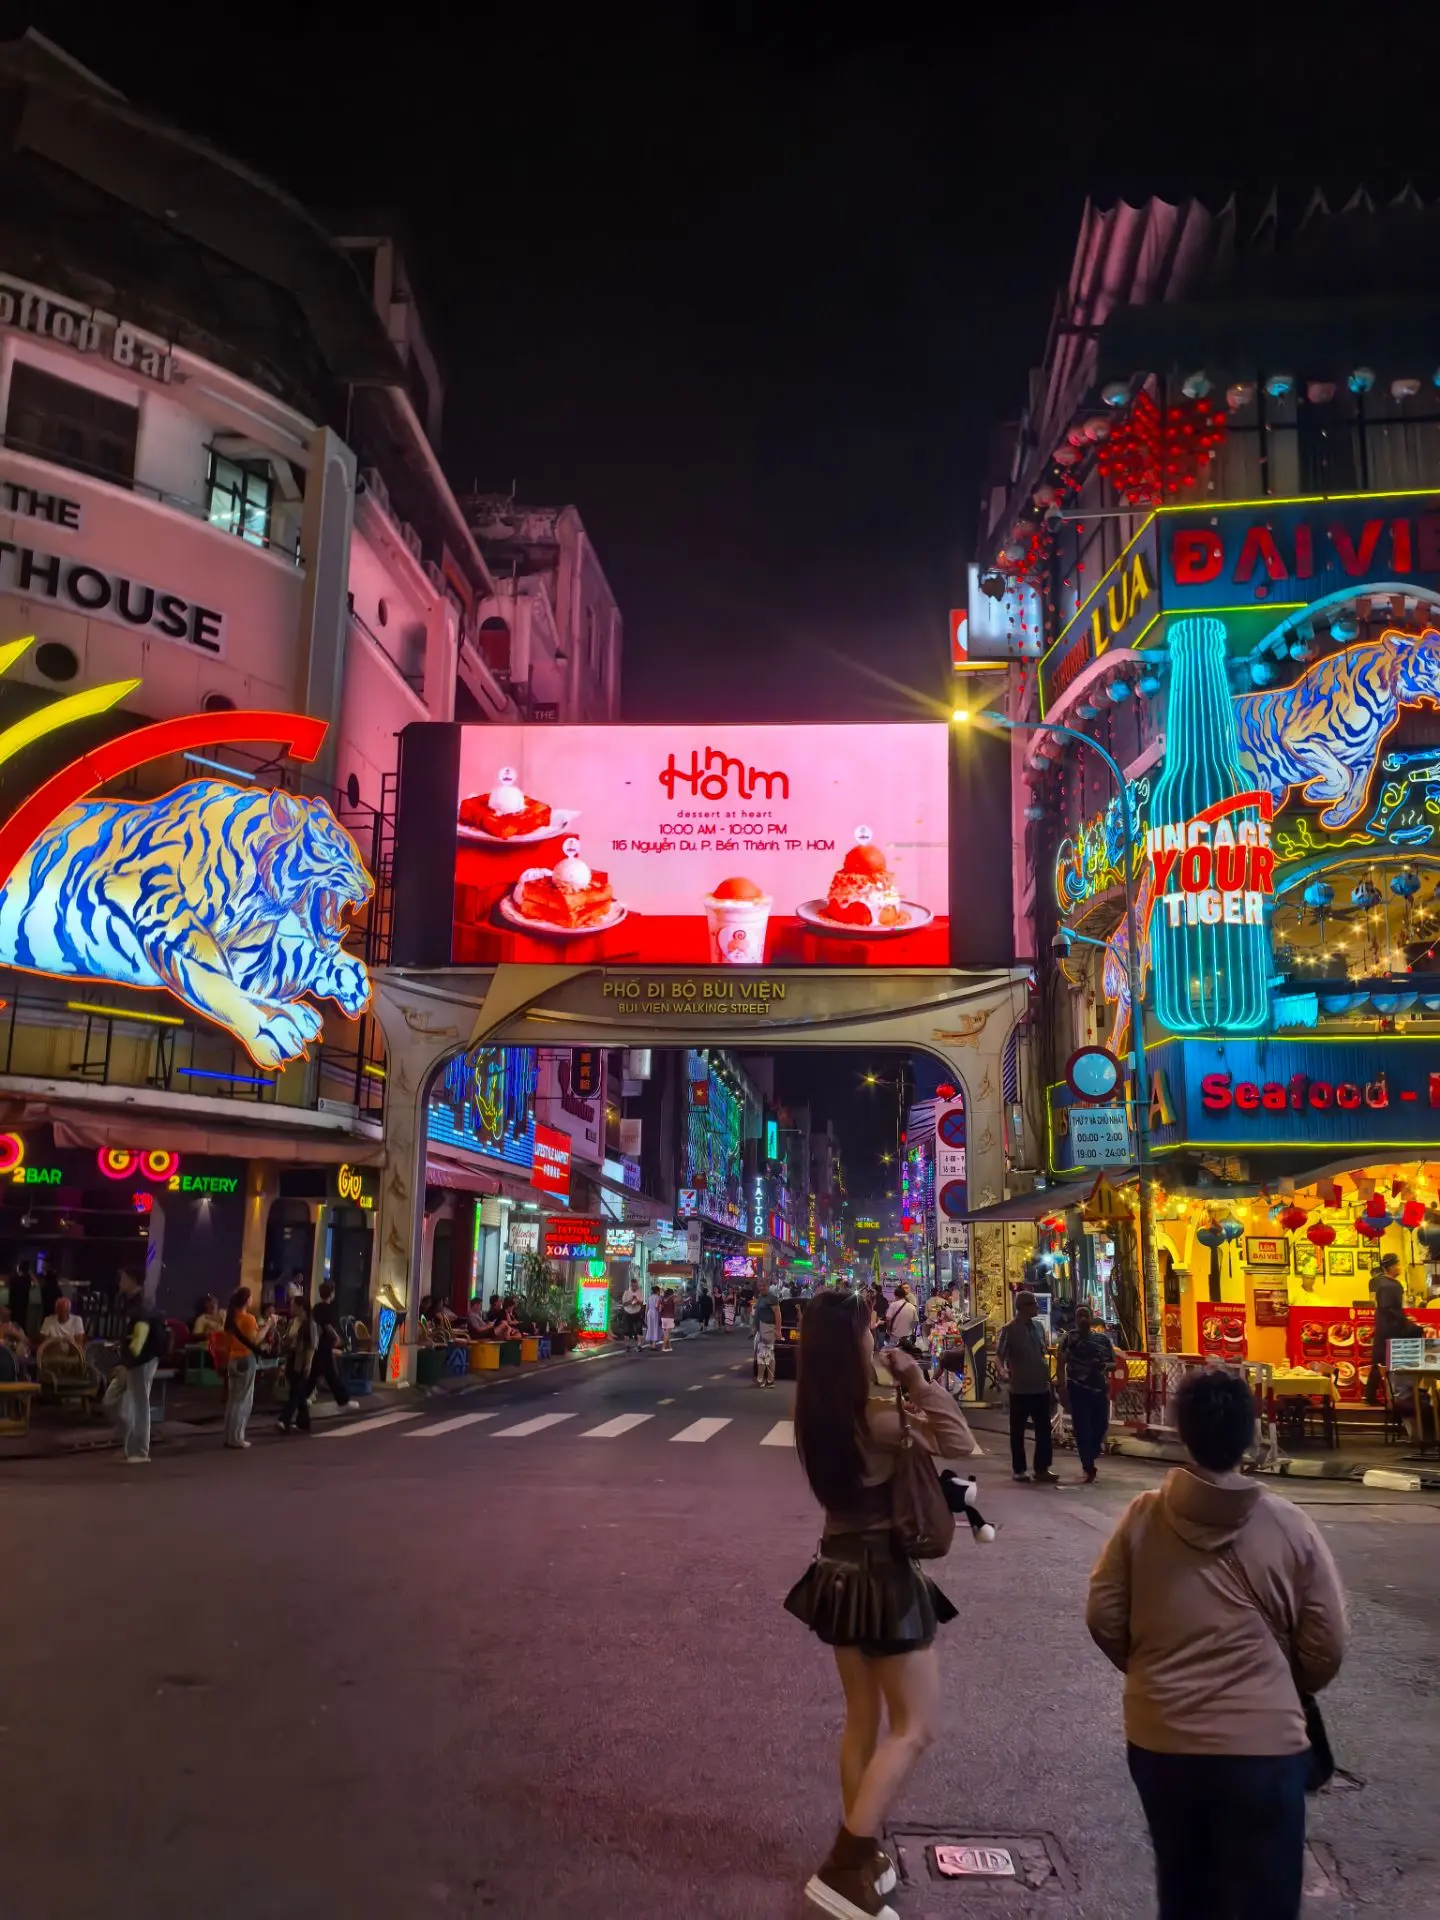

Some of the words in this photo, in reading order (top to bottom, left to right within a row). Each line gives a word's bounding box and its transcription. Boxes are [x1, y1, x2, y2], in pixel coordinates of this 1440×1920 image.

[113, 327, 179, 383] Bar
[3, 482, 81, 530] THE
[659, 823, 693, 835] 10:00
[697, 824, 716, 834] AM
[729, 823, 763, 835] 10:00
[768, 824, 787, 834] PM
[677, 809, 720, 818] dessert
[726, 810, 736, 818] at
[741, 809, 772, 818] heart
[612, 839, 627, 851] 116
[807, 839, 834, 851] HCM
[1146, 818, 1272, 862] UNCAGE
[1151, 845, 1275, 897] YOUR
[1162, 889, 1263, 928] TIGER
[602, 976, 641, 998] PHỐ
[647, 982, 665, 998] ĐI
[671, 979, 697, 1001] BỘ
[703, 979, 734, 998] BÙI
[740, 980, 786, 1001] VIỆN
[618, 1003, 638, 1014] BUI
[641, 1003, 670, 1014] VIEN
[672, 1003, 728, 1014] WALKING
[731, 1003, 770, 1014] STREET
[1201, 1071, 1390, 1110] Seafood
[26, 1167, 62, 1184] BAR
[182, 1175, 238, 1192] EATERY
[754, 1177, 763, 1235] TATTOO
